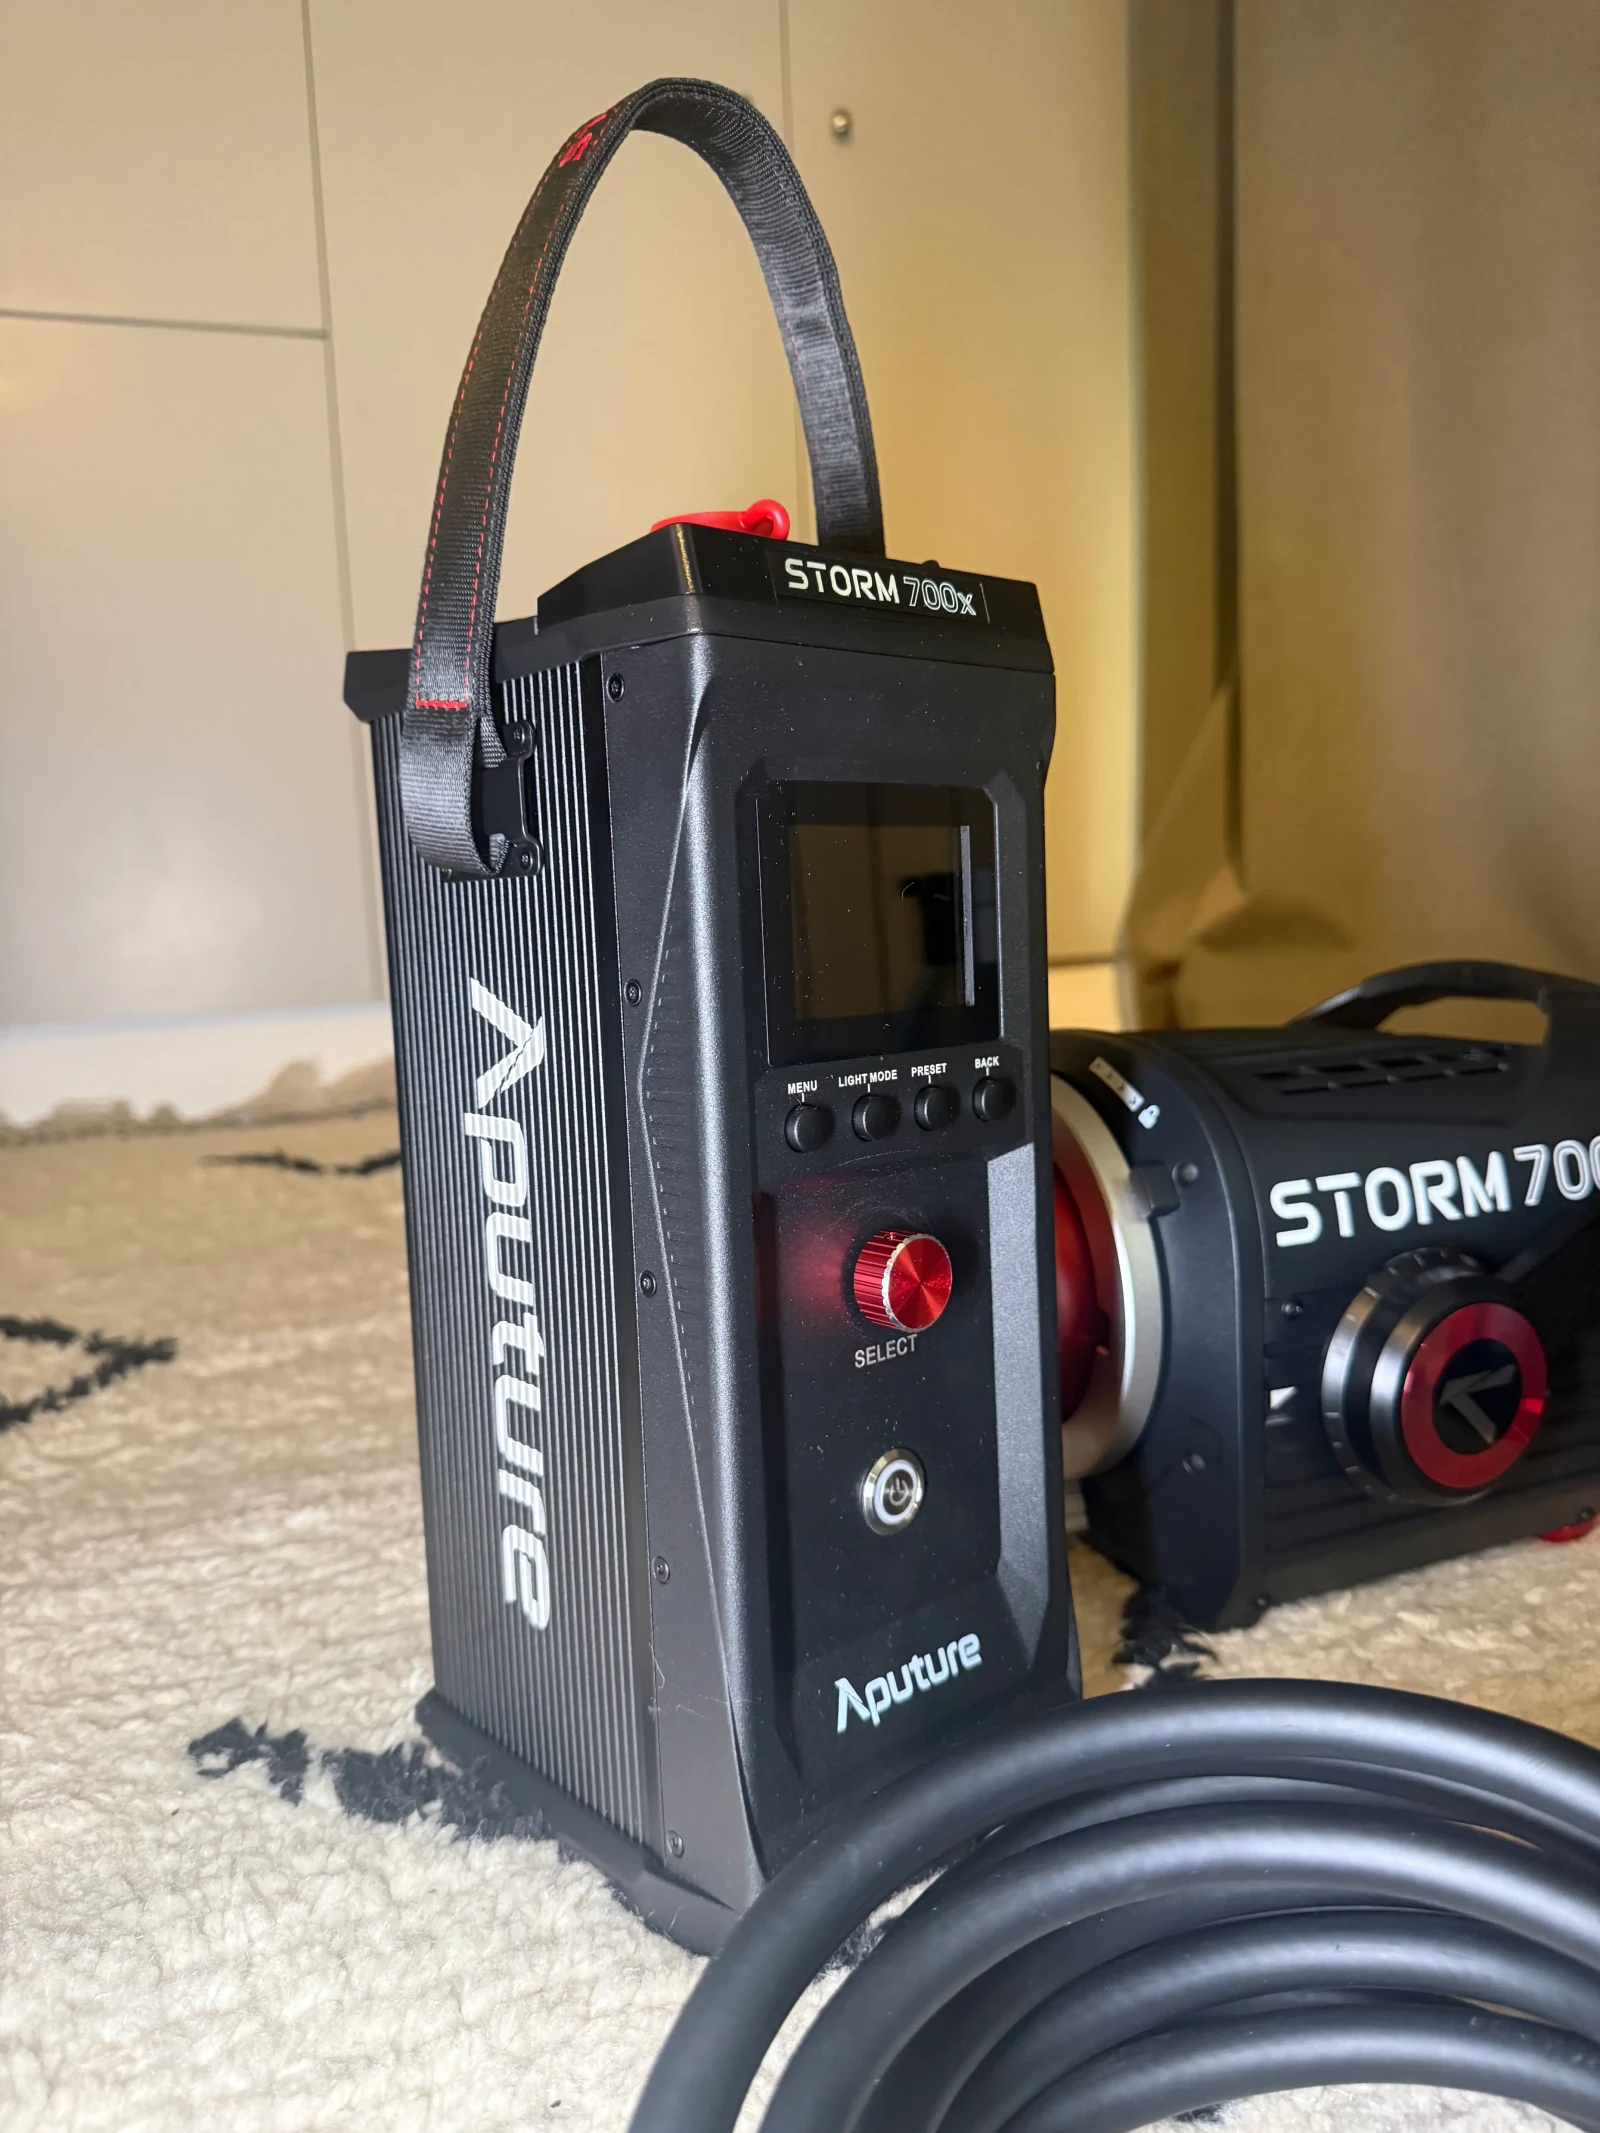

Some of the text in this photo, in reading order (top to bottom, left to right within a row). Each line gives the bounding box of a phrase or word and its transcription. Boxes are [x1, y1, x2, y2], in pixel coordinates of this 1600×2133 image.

[785, 558, 976, 616] STORM 700x
[838, 1069, 898, 1088] LIGHT MODE
[911, 1062, 948, 1077] PRESET
[974, 1056, 1000, 1069] BACK
[787, 1080, 818, 1095] MENU
[1270, 1151, 1512, 1248] STORM
[464, 977, 551, 1632] Aputure
[854, 1333, 918, 1369] SELECT
[834, 1633, 983, 1733] Aputure
